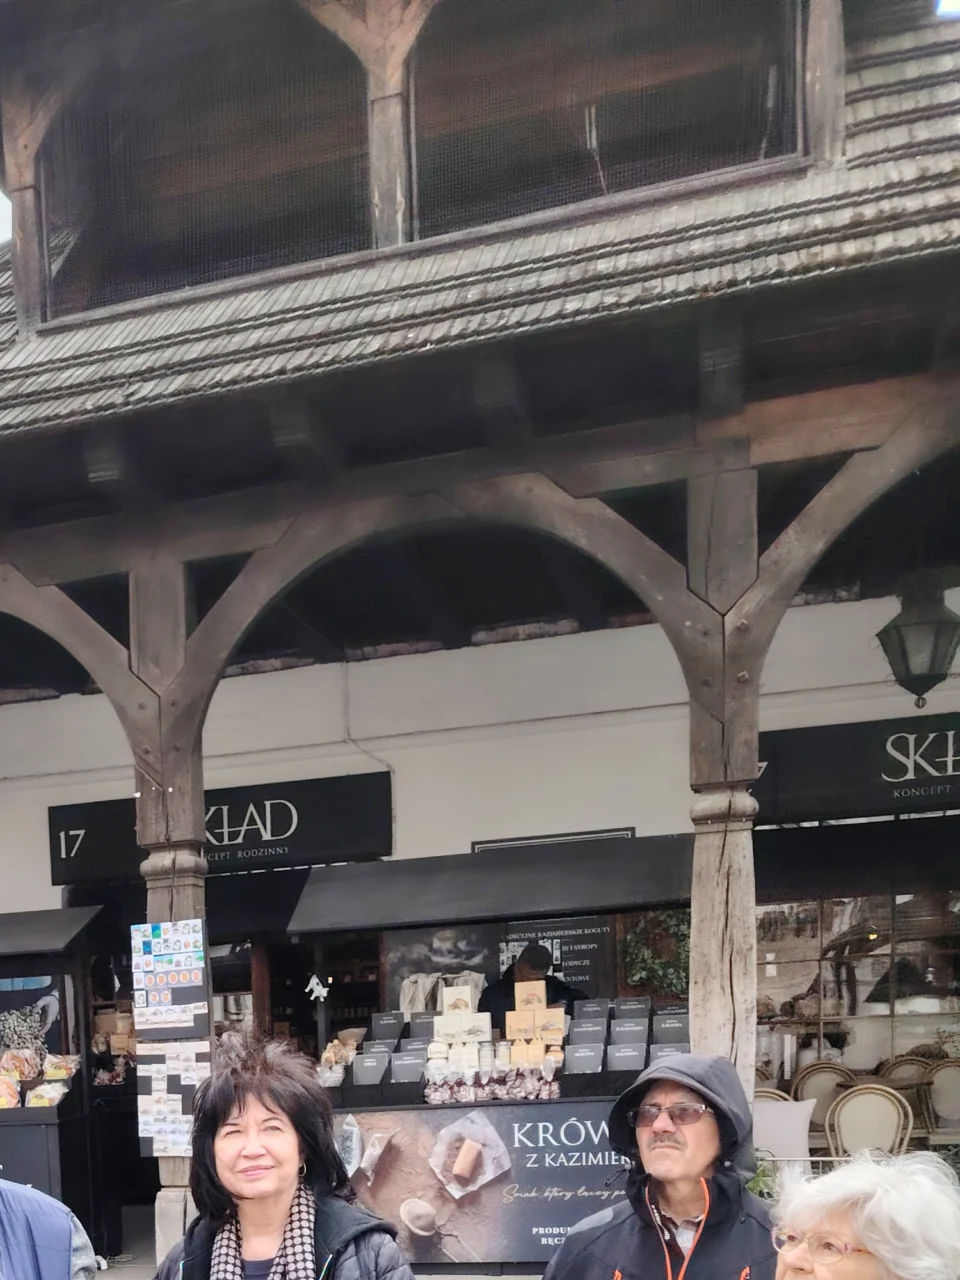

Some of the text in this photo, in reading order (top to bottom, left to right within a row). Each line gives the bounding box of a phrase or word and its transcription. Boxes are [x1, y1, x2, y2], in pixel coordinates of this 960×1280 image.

[881, 730, 960, 782] SKŁ
[204, 799, 299, 846] KŁAD
[58, 828, 86, 859] 17
[237, 845, 290, 859] RODZINNY
[512, 1116, 610, 1148] KRÓW
[526, 1153, 539, 1168] Z
[532, 1226, 571, 1235] PRODU
